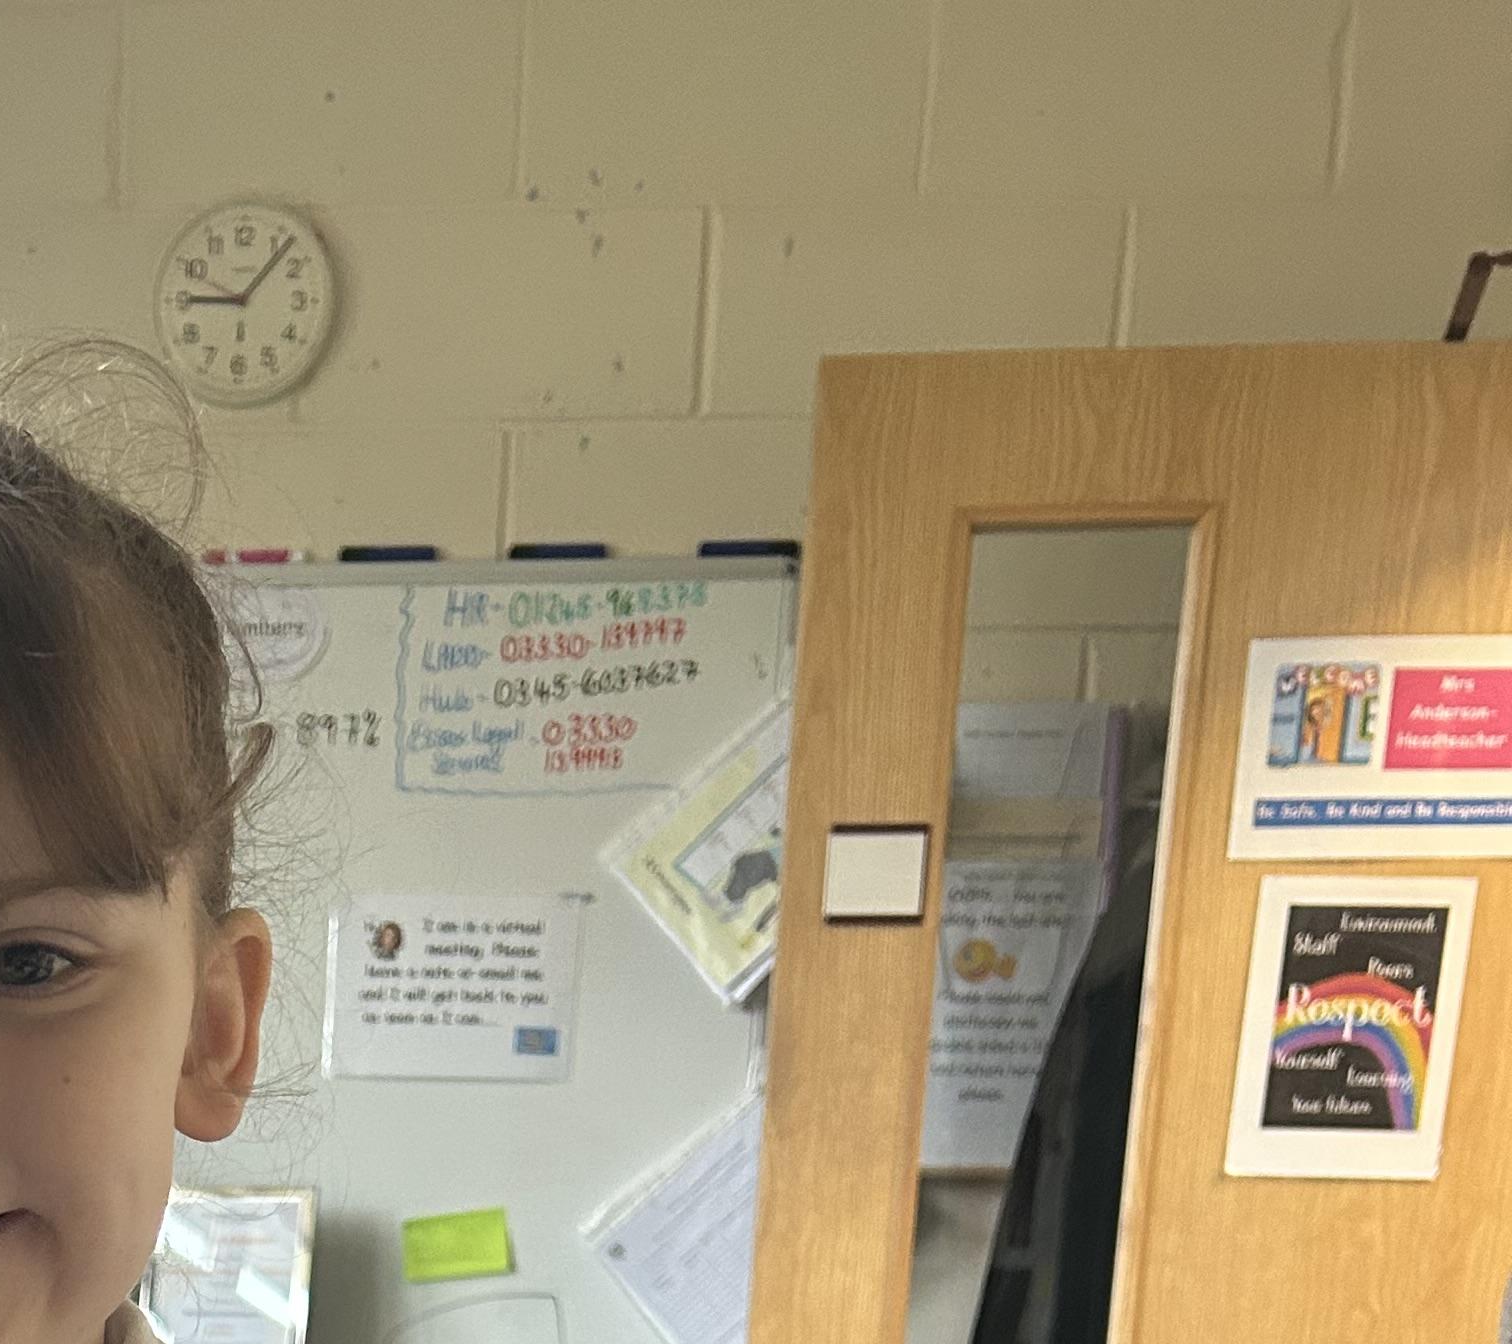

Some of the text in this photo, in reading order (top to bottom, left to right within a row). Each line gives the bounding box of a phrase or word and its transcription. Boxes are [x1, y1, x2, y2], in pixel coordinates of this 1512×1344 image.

[207, 234, 225, 255] 11
[235, 226, 256, 246] 12
[184, 258, 208, 279] 10
[286, 257, 304, 278] 2
[291, 291, 308, 311] 3
[182, 323, 200, 344] 8
[280, 323, 297, 341] 4
[202, 346, 219, 365] 7
[230, 354, 248, 375] 6
[260, 346, 278, 367] 5
[1439, 673, 1476, 692] Mrs
[1286, 982, 1433, 1043] Respect
